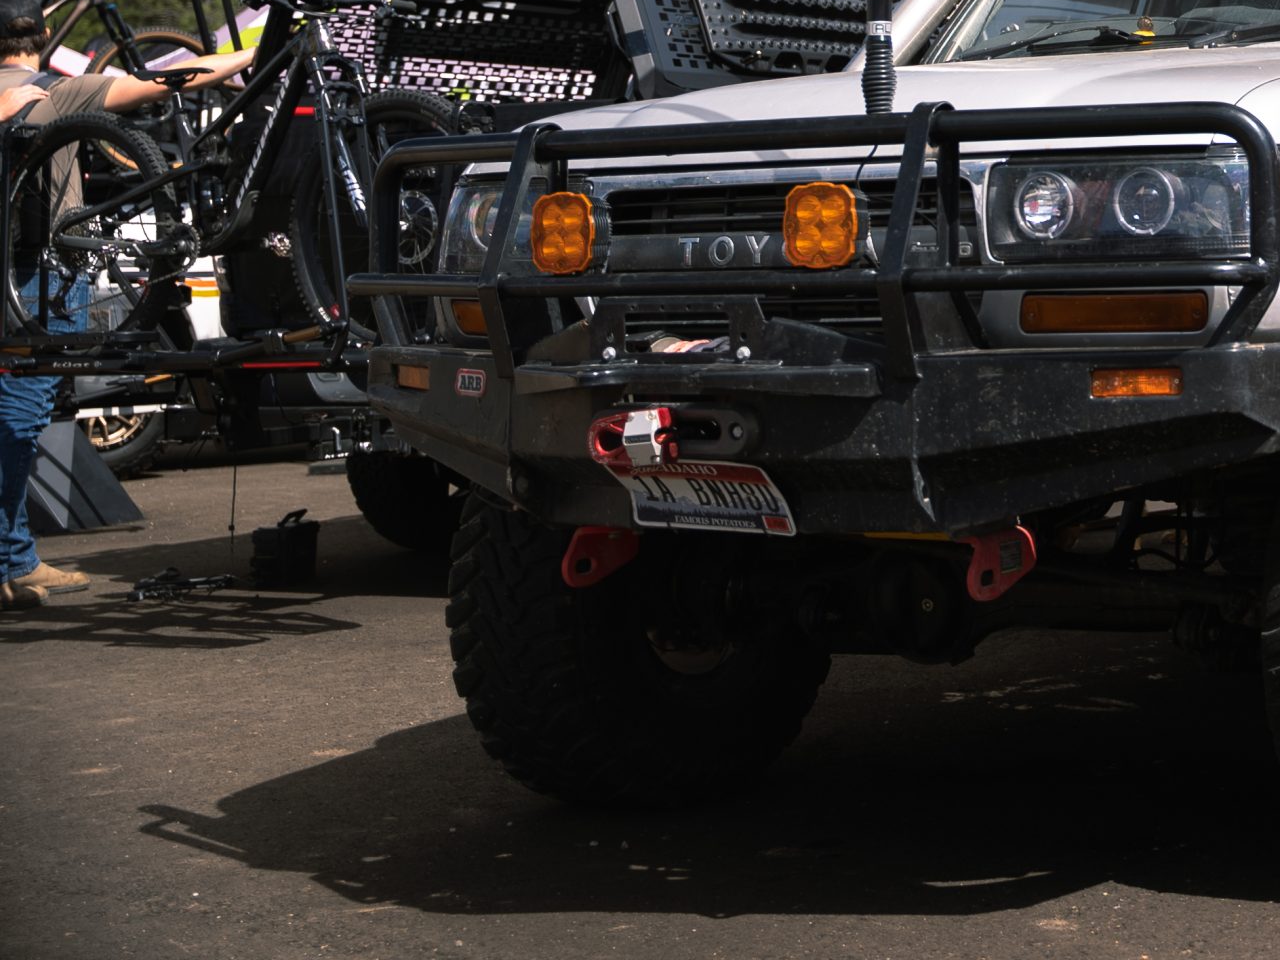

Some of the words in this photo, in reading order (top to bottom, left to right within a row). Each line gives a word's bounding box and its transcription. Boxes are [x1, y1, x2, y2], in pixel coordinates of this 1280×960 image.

[678, 235, 788, 266] TOY
[459, 374, 482, 390] ARB
[662, 463, 718, 477] IDAHO
[632, 475, 676, 503] 1A
[675, 515, 710, 526] FAMOUS
[711, 518, 757, 529] POTATOES
